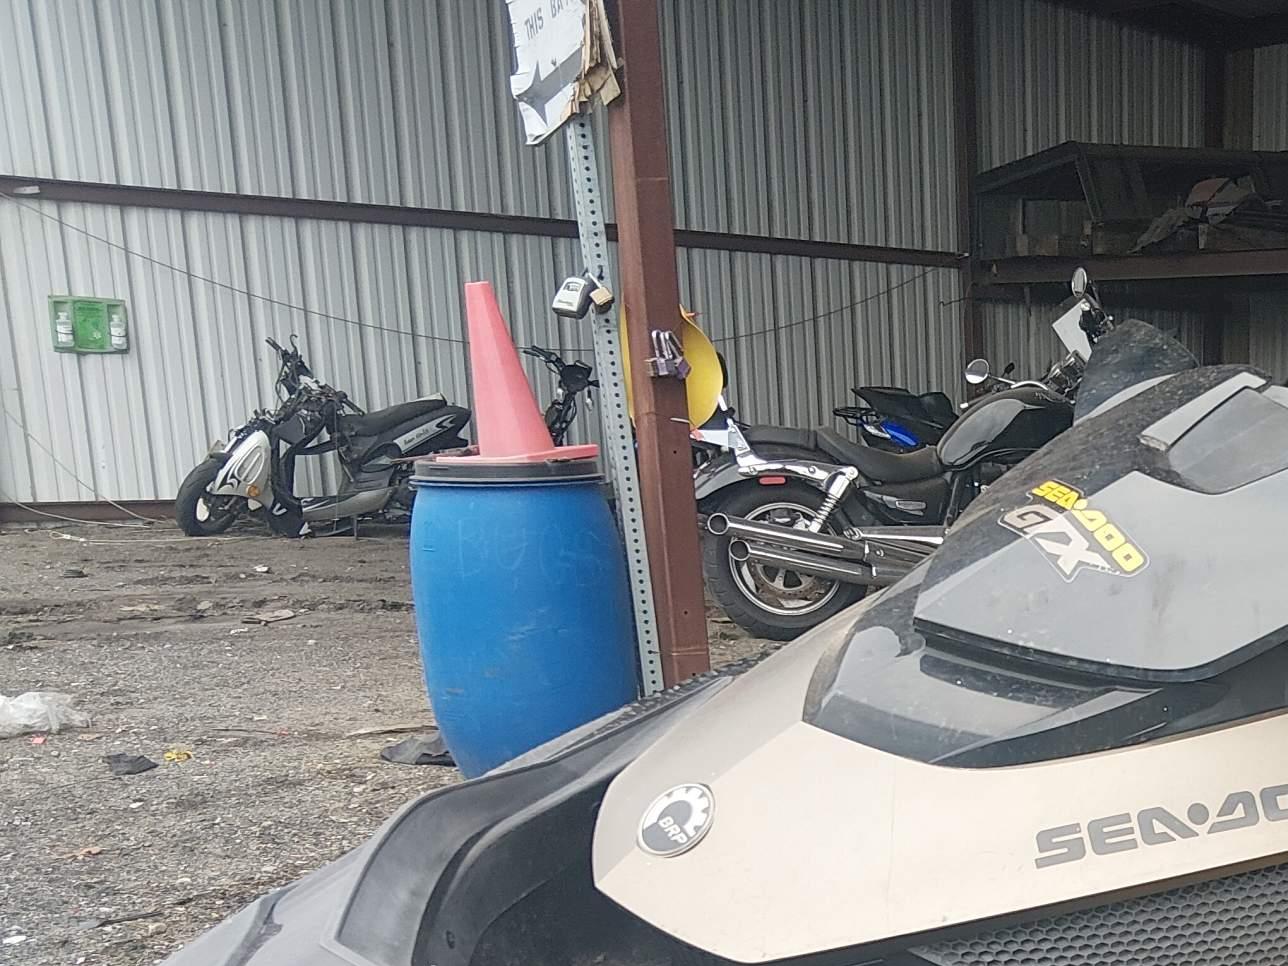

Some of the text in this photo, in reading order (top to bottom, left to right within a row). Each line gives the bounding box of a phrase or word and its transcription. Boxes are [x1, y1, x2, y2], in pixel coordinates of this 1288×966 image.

[524, 7, 544, 41] THIS
[1001, 504, 1112, 575] GTX
[658, 816, 688, 844] BRP
